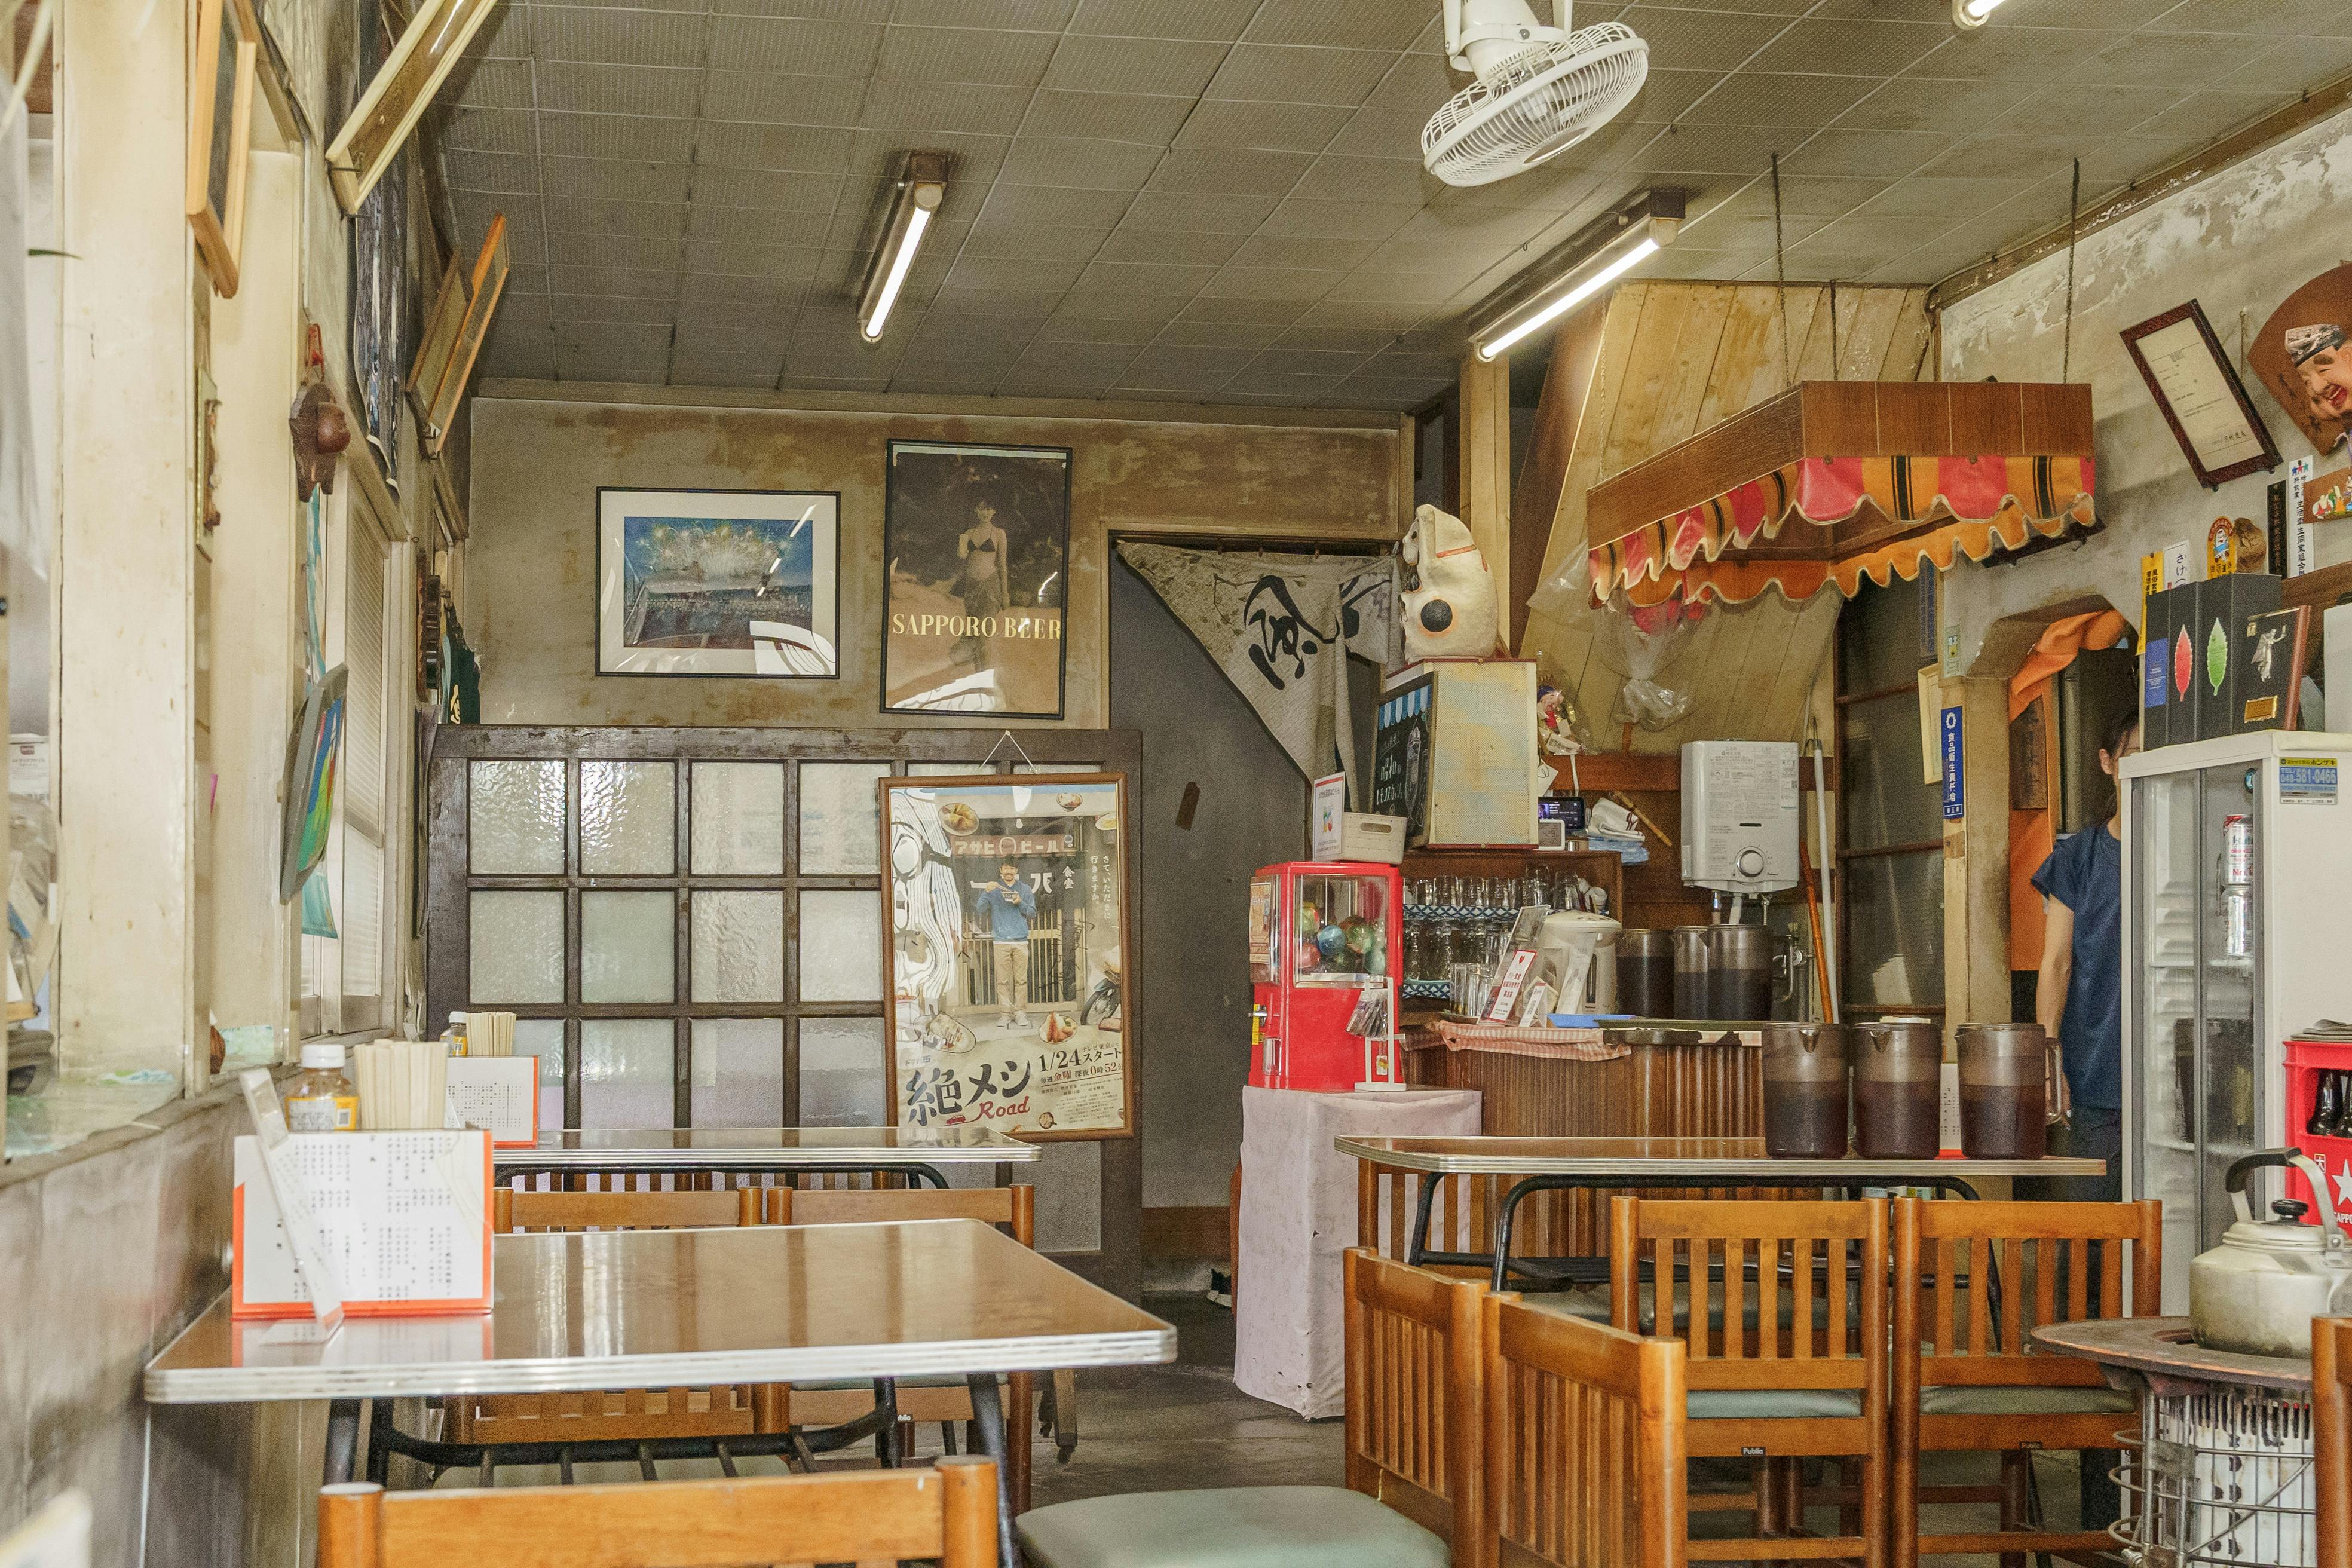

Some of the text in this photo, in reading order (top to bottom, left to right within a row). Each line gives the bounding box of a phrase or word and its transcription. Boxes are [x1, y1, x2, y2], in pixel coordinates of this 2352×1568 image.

[893, 613, 1061, 639] SAPPORO BEER
[956, 840, 1059, 855] アサヒ ビール
[1090, 855, 1100, 904] 行きますか。
[1038, 1048, 1122, 1072] 1/24 スタート
[905, 1059, 1031, 1127] 絶メシ
[978, 1095, 1031, 1119] Road
